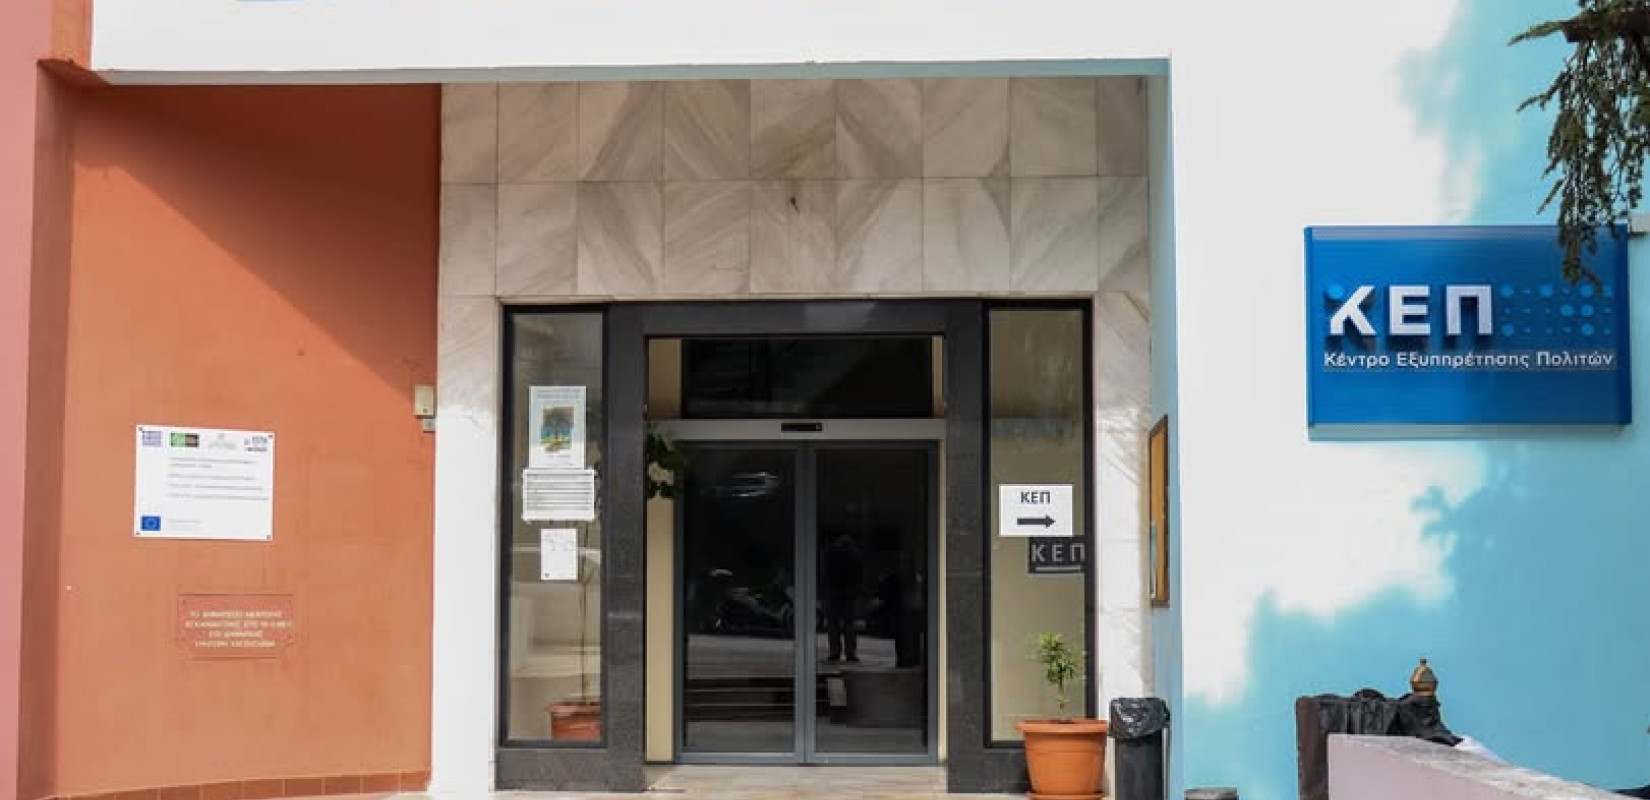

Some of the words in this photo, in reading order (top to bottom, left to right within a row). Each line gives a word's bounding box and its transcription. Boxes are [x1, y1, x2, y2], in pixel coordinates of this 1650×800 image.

[1329, 285, 1493, 336] ΚΕΠ
[1324, 351, 1390, 368] Κέντρο
[1397, 351, 1529, 368] Εξυπηρέτησης
[1537, 350, 1613, 367] Πολιτών
[1020, 491, 1051, 504] ΚΕΠ
[1031, 543, 1085, 562] ΚΕΠ
